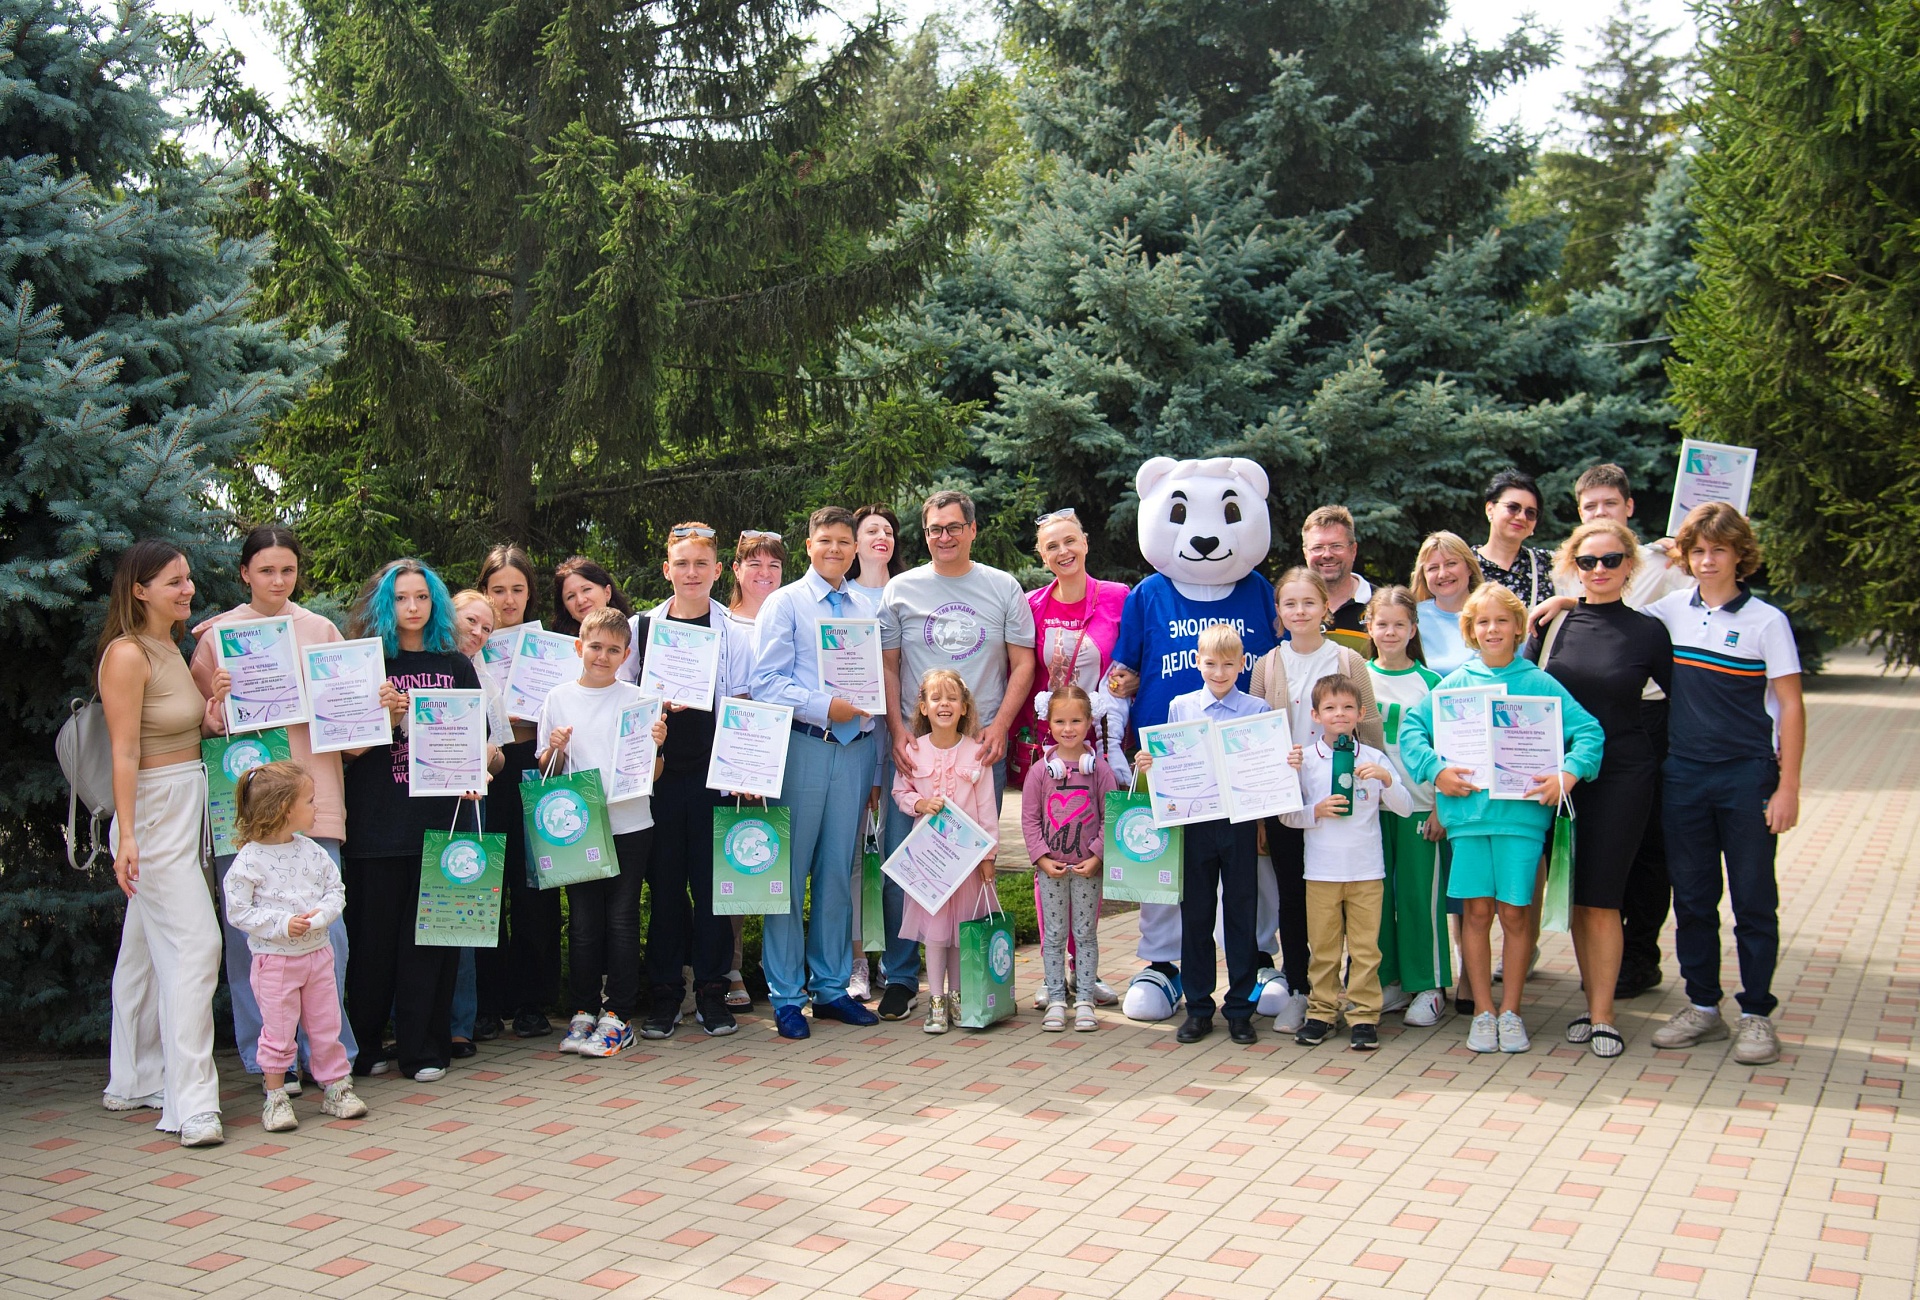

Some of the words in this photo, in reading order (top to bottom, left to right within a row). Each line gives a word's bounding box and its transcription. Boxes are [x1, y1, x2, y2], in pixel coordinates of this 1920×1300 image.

[950, 605, 976, 615] КАЖДОГО
[224, 628, 261, 640] СЕРТИФИКАТ
[658, 627, 691, 637] СЕРТИФИКАТ
[526, 636, 560, 648] СЕРТИФИКАТ
[314, 653, 342, 664] ДИПЛОМ
[1442, 696, 1476, 706] СЕРТИФИКАТ
[729, 709, 755, 718] ДИПЛОМ
[1150, 730, 1185, 742] СЕРТИФИКАТ
[1226, 727, 1251, 739] ДИПЛОМ
[940, 810, 962, 830] ДИПЛОМ
